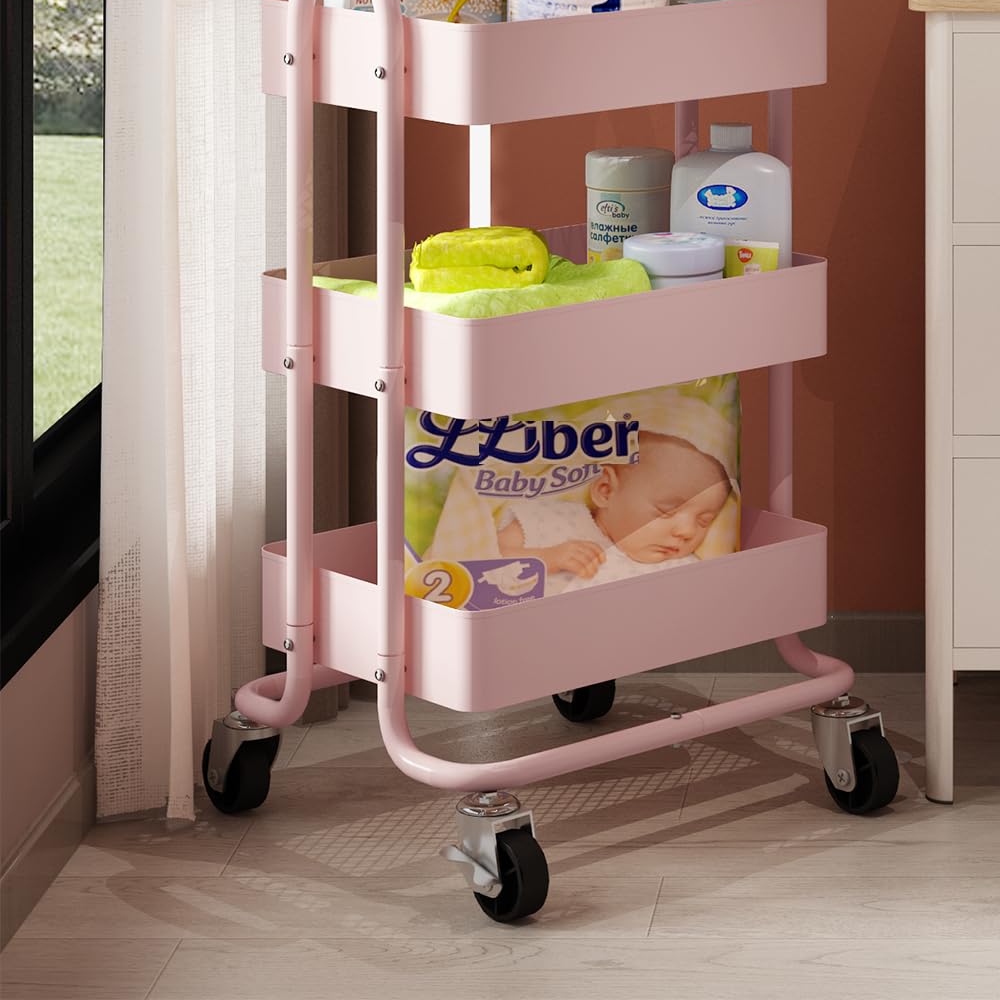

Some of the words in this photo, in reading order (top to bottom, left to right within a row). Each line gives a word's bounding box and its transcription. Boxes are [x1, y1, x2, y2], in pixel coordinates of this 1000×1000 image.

[612, 211, 630, 219] baby
[475, 469, 547, 498] Baby
[423, 569, 454, 602] 2
